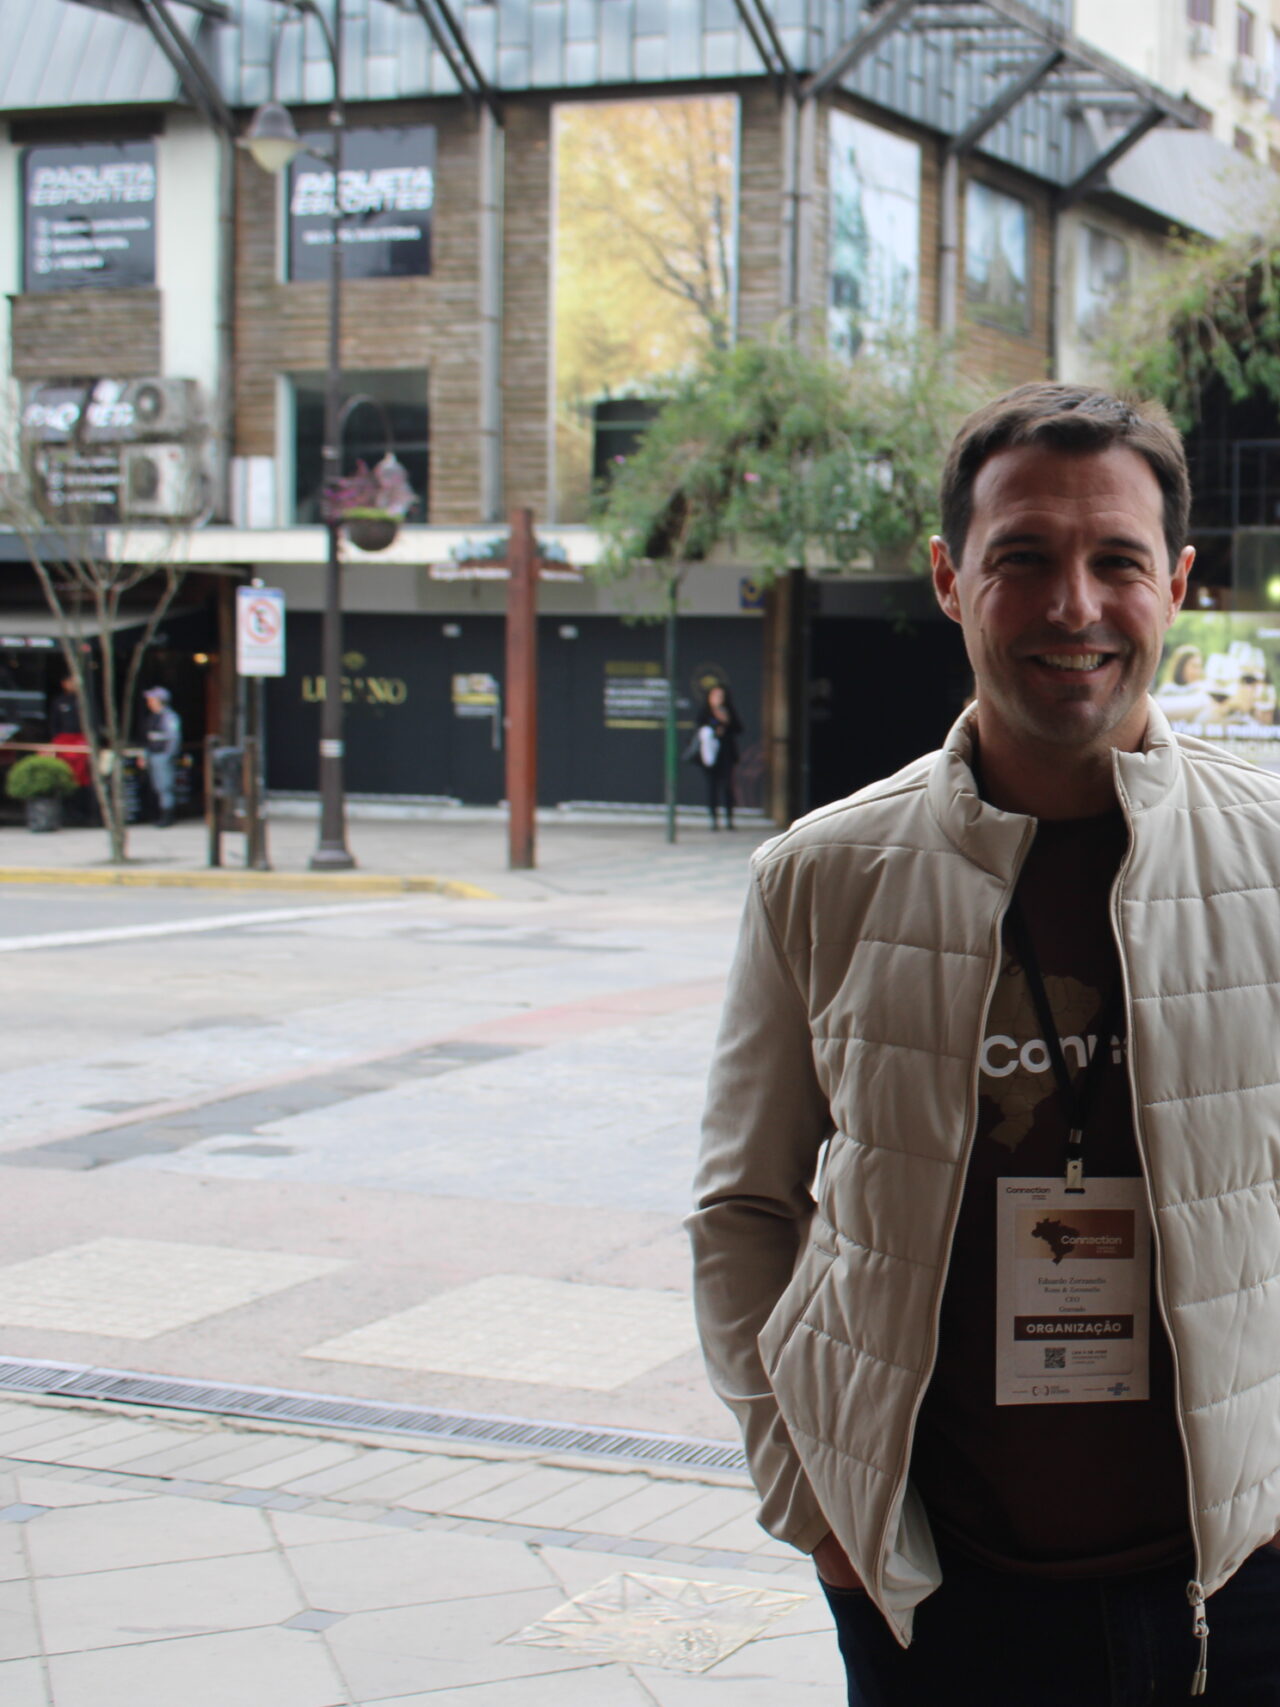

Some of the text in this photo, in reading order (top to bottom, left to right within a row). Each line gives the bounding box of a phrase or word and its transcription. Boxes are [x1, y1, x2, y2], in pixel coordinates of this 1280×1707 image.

[1006, 1186, 1051, 1194] Connection
[1060, 1235, 1122, 1245] Connection
[1025, 1320, 1122, 1335] ORGANIZAÇÃO
